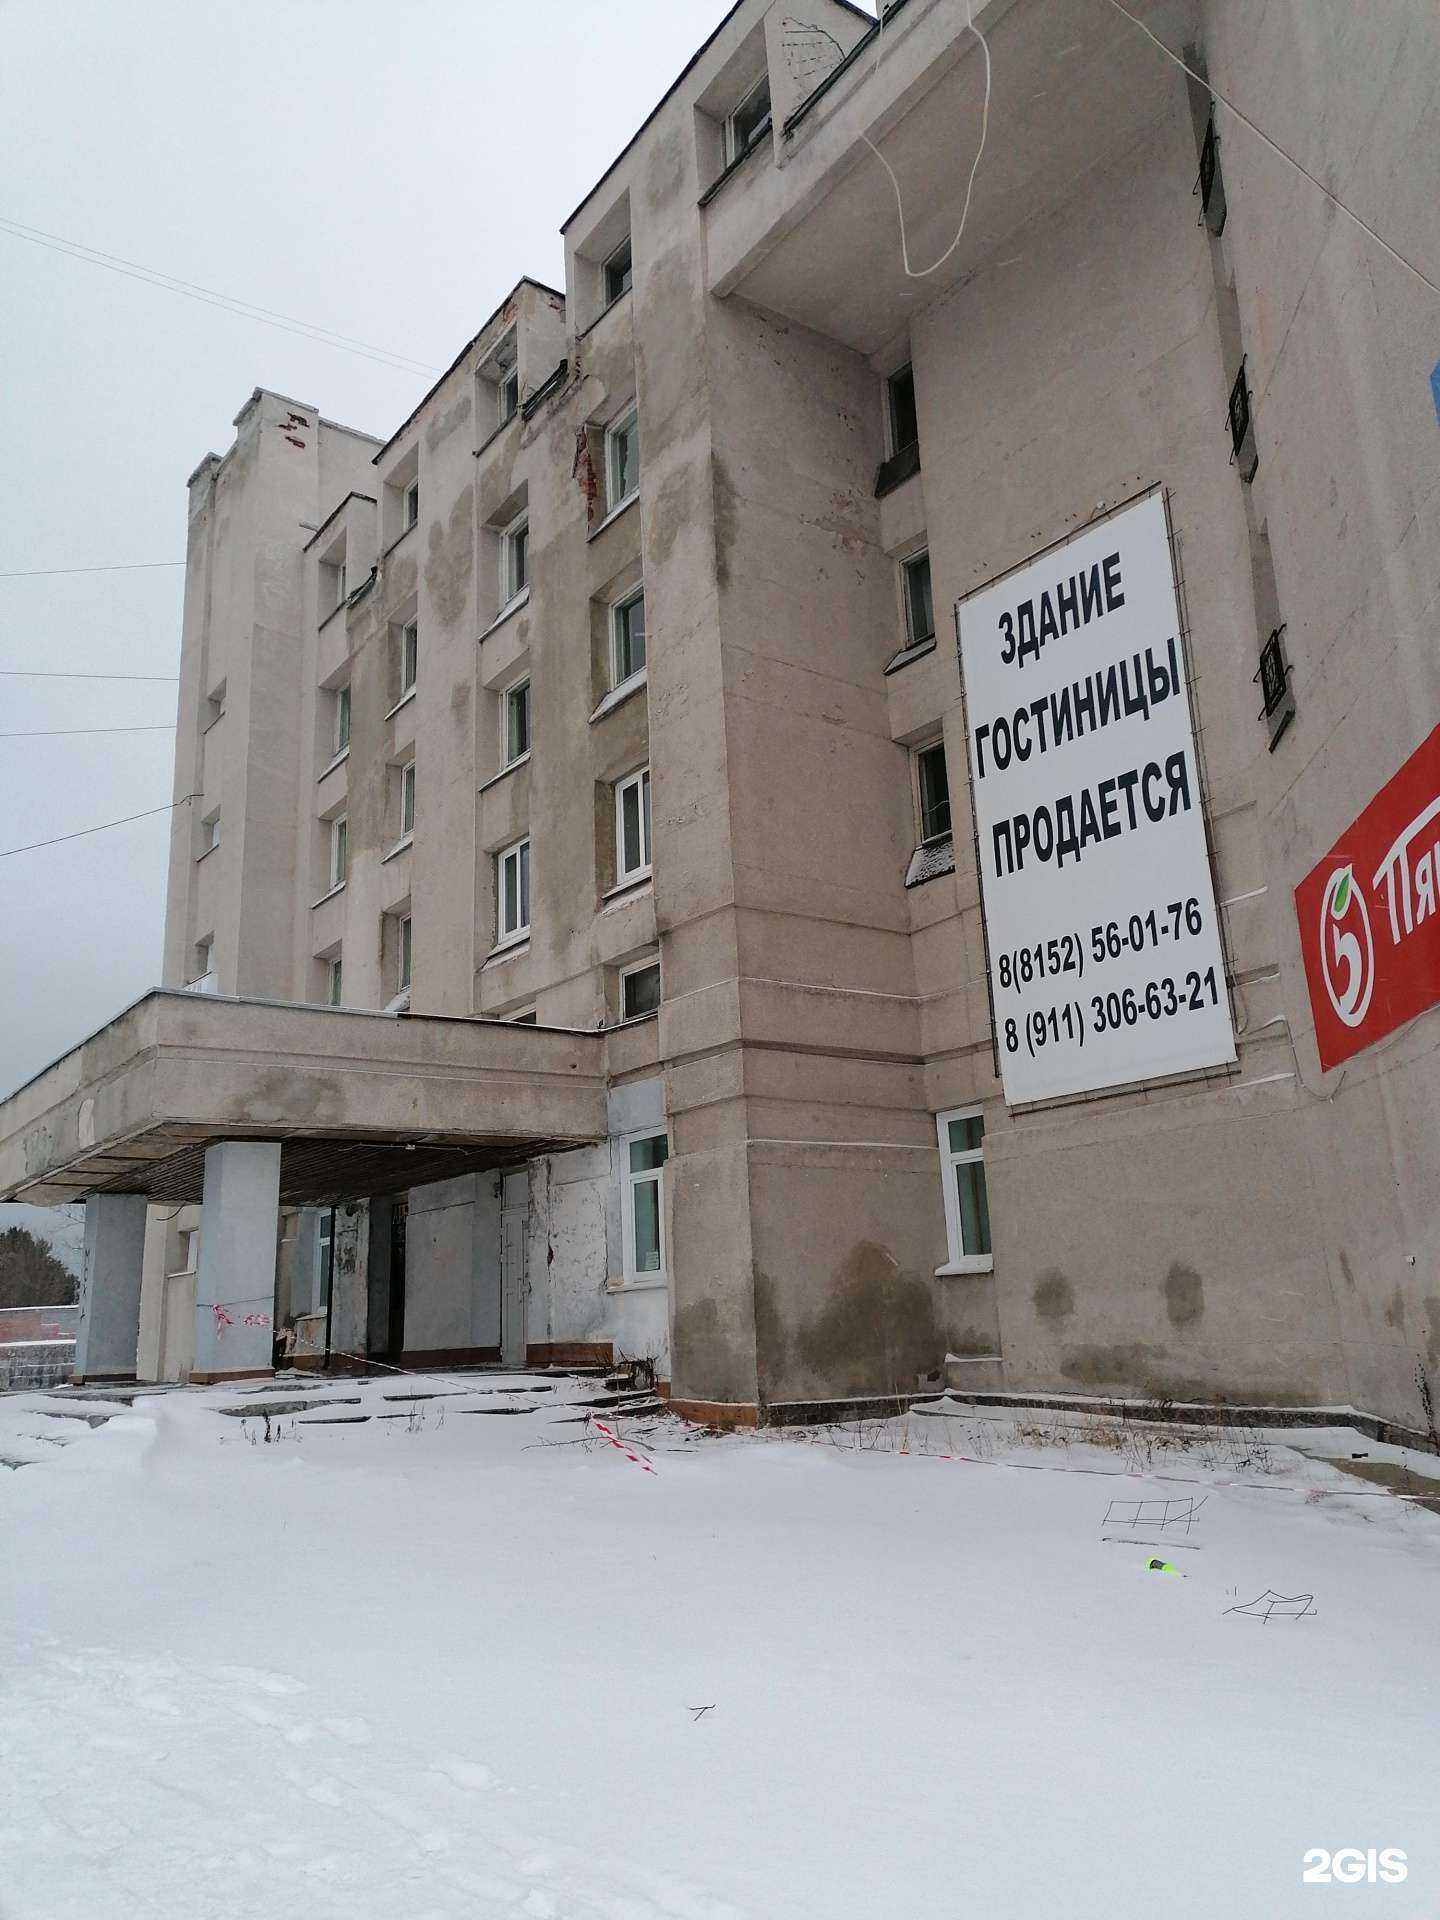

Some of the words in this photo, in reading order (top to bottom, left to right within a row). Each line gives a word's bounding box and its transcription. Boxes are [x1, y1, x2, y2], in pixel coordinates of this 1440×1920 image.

[997, 551, 1126, 669] ЗДАНИЕ
[974, 636, 1182, 779] ГОСТИНИЦЫ
[992, 750, 1192, 878] ПРОДАЕТСЯ
[1372, 795, 1440, 946] Пя
[998, 932, 1085, 995] 8(8152)
[1090, 897, 1203, 964] 56-01-76
[1004, 1017, 1019, 1053] 8
[1025, 1001, 1085, 1058] (911)
[1090, 966, 1220, 1034] 306-63-21
